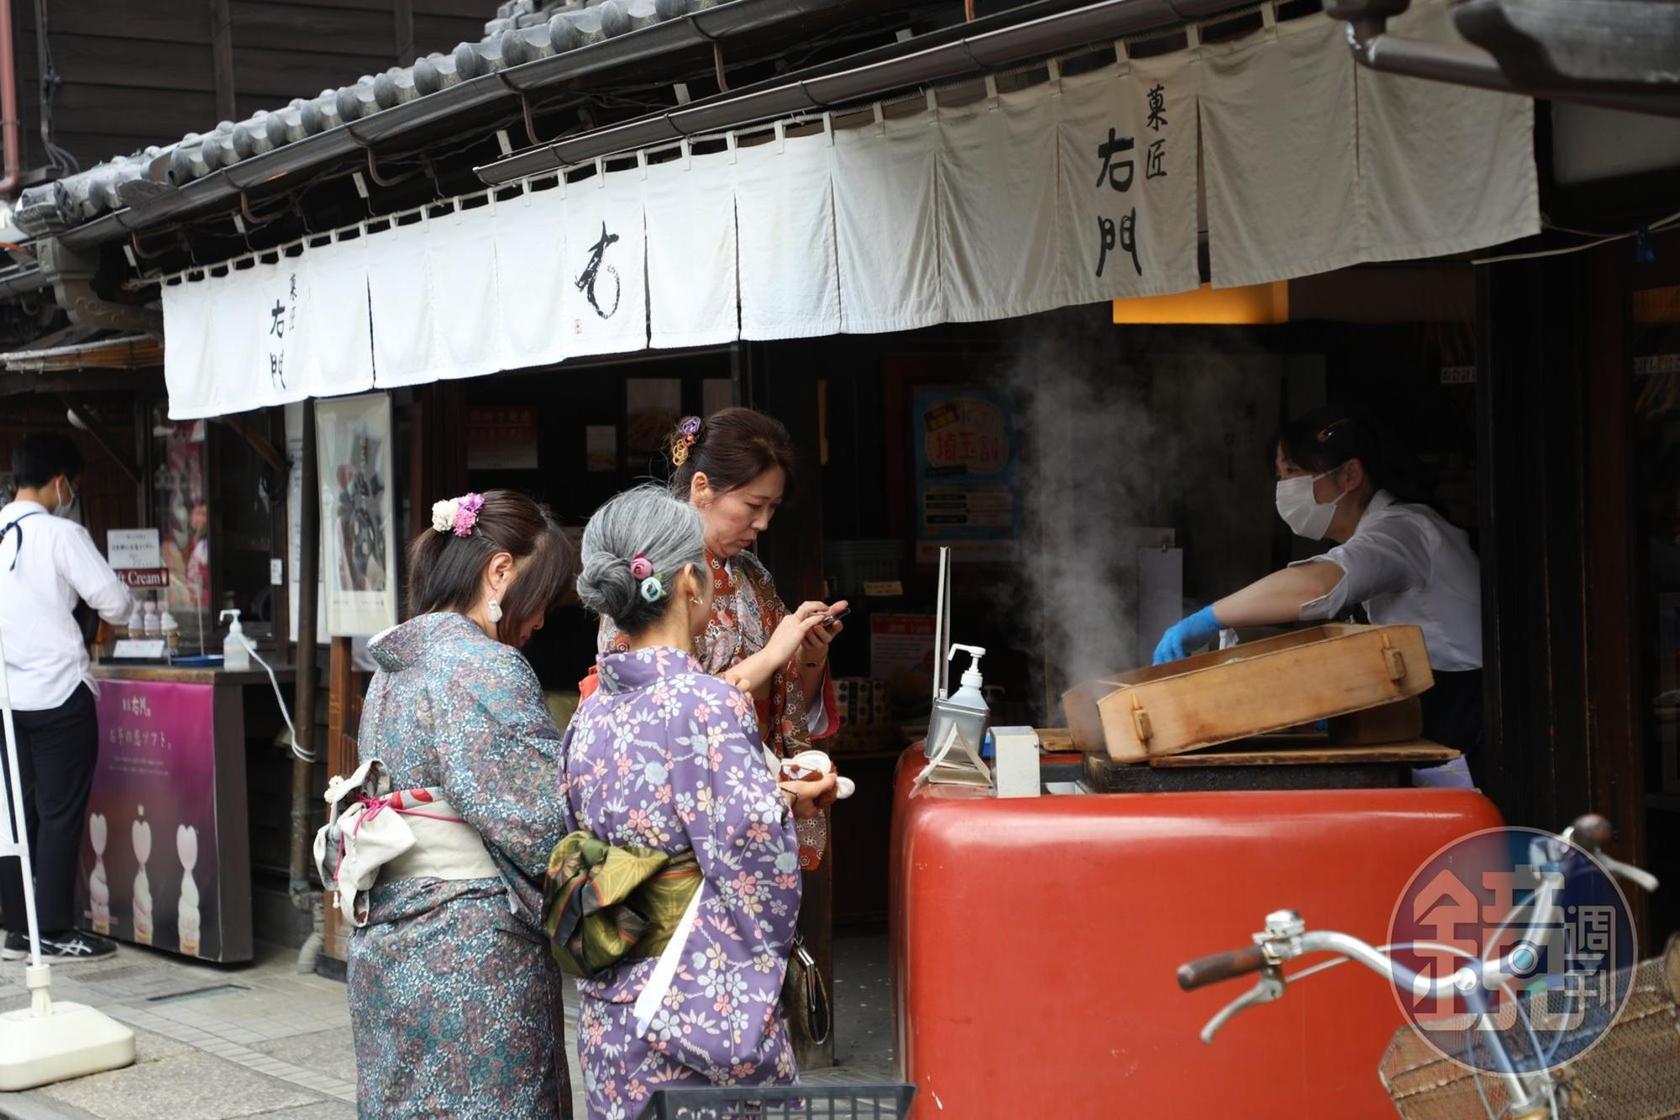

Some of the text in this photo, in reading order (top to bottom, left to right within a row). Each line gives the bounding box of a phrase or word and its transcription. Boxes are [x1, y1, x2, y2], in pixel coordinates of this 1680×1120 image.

[1095, 127, 1143, 278] 右門
[269, 298, 287, 391] 右門
[128, 570, 161, 586] Cream
